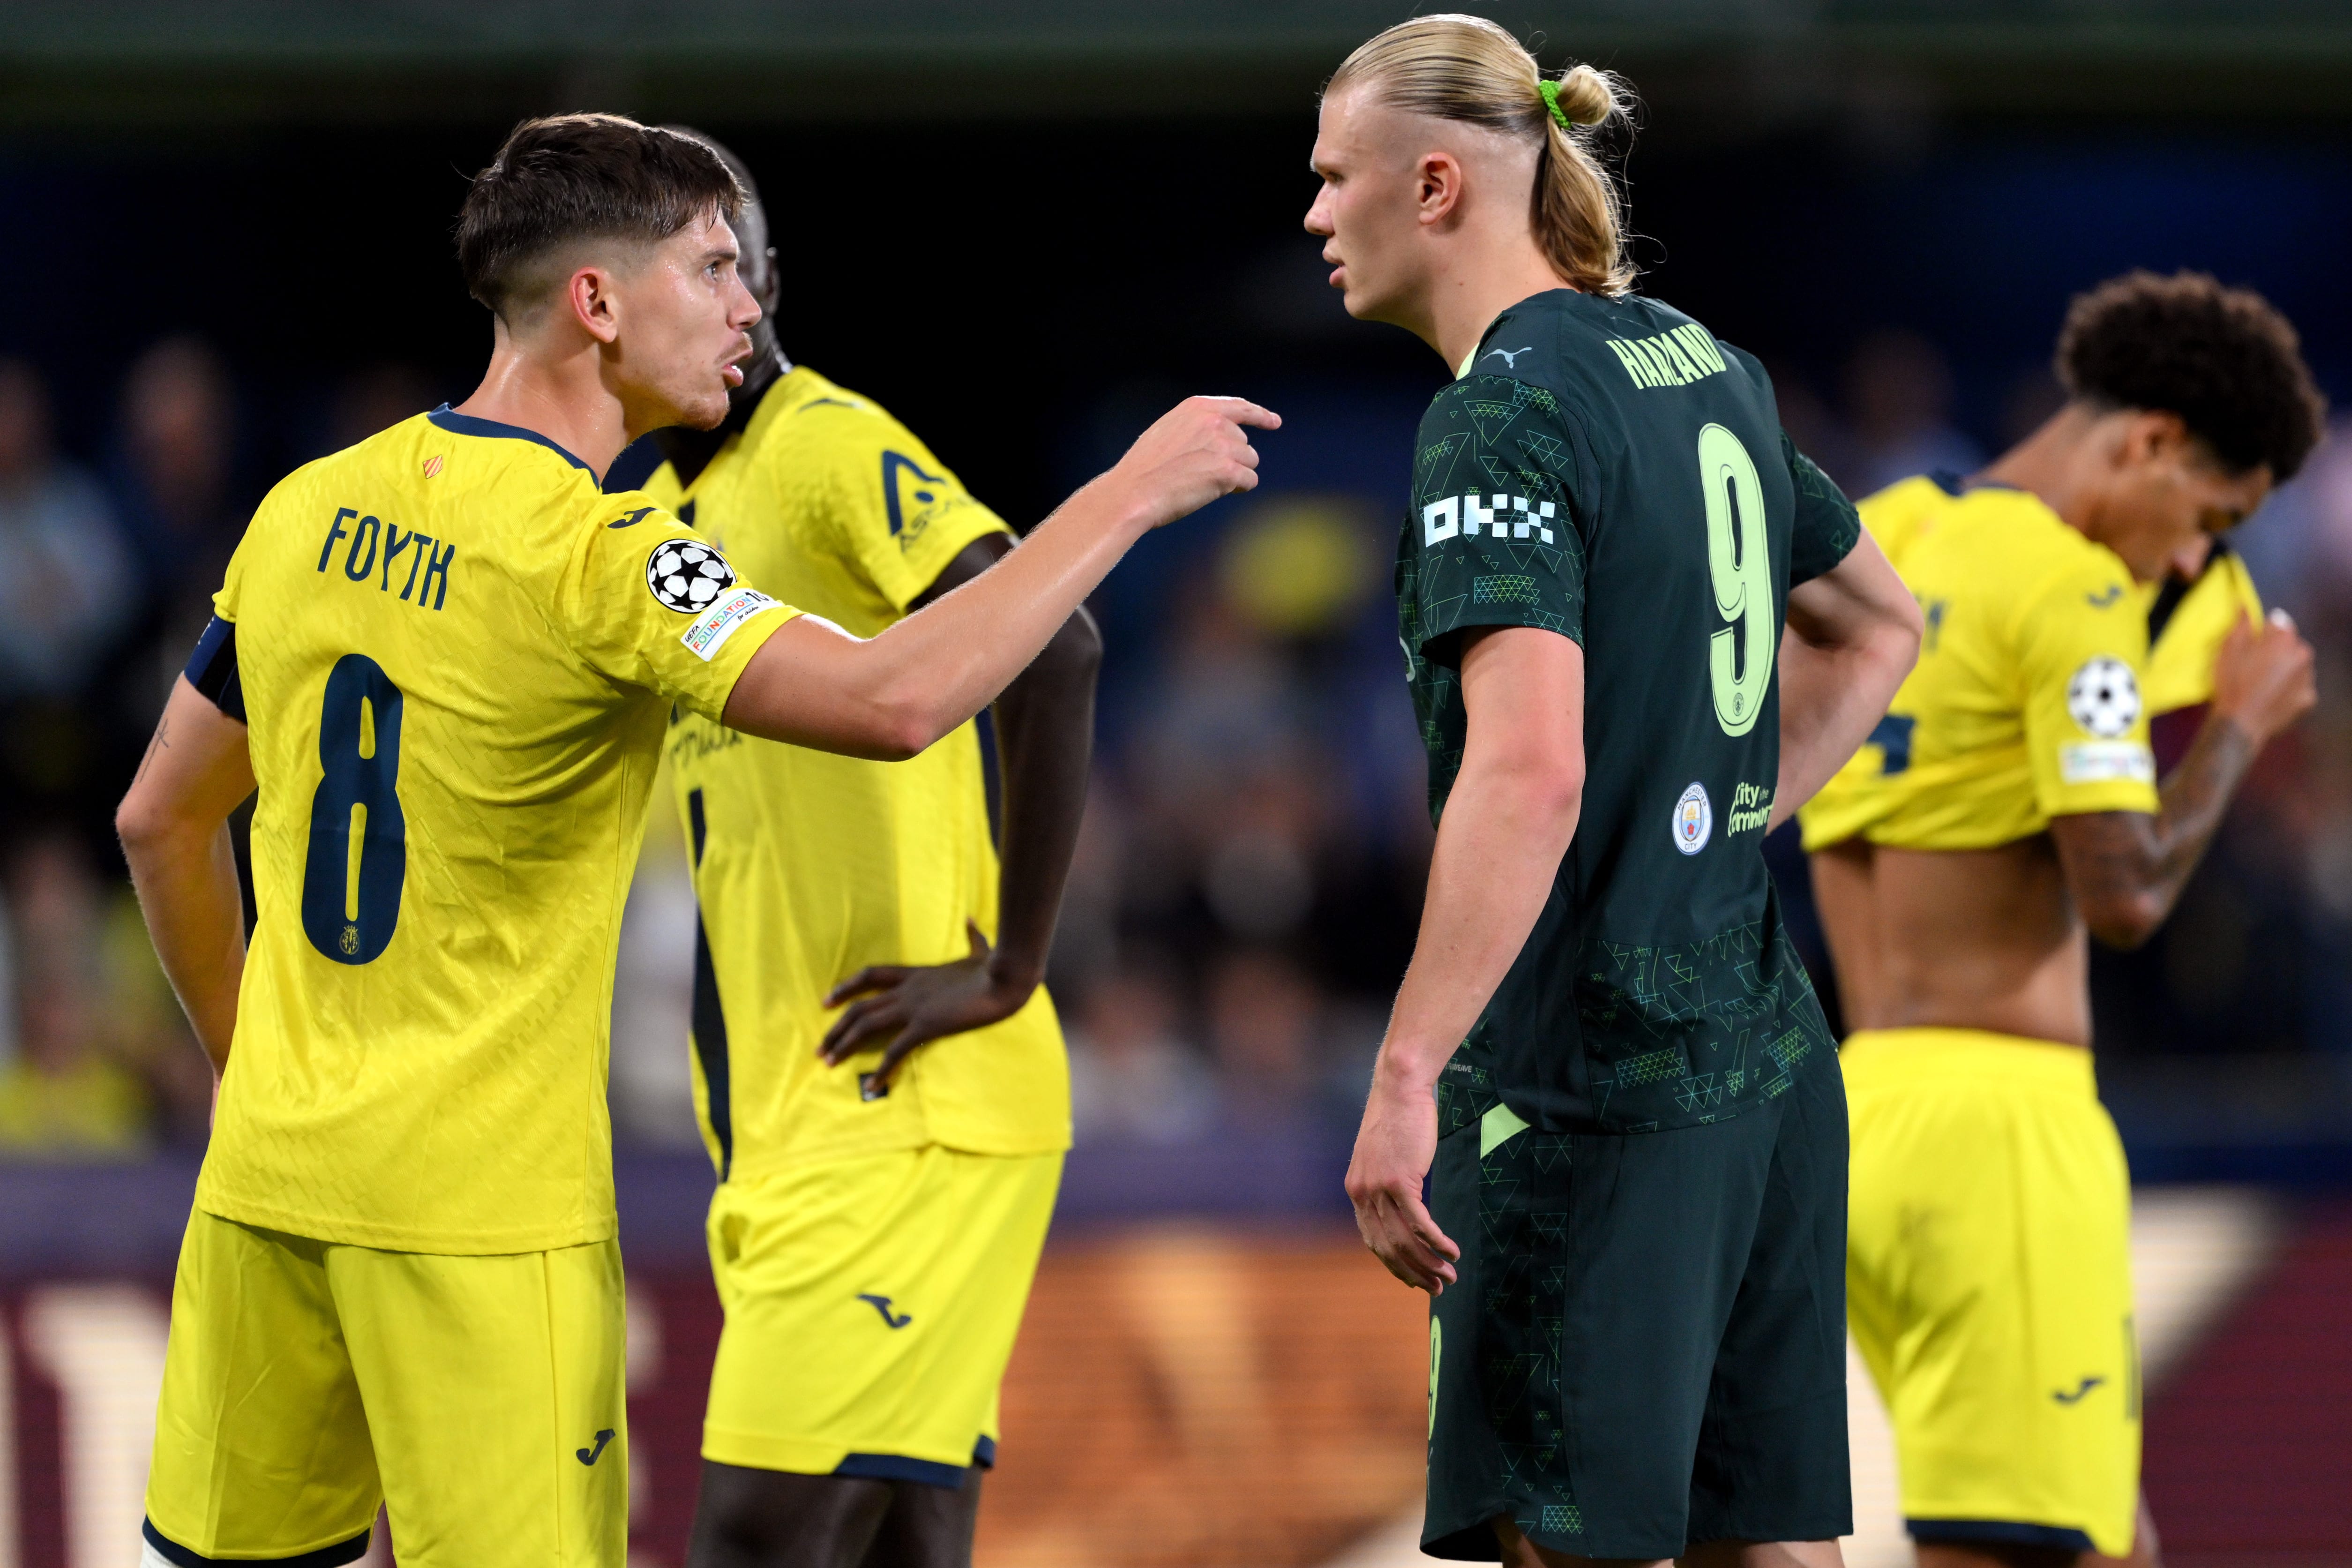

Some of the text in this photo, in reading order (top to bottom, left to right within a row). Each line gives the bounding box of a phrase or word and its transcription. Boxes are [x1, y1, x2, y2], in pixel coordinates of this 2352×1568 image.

[1423, 494, 1556, 548] OKX
[317, 507, 455, 611] FOYTH
[1698, 422, 1775, 737] 9
[685, 625, 700, 643] UEFA
[692, 596, 752, 651] FOUNDATION
[744, 606, 760, 615] children
[301, 653, 406, 966] 8
[1678, 787, 1707, 810] MANCHESTER
